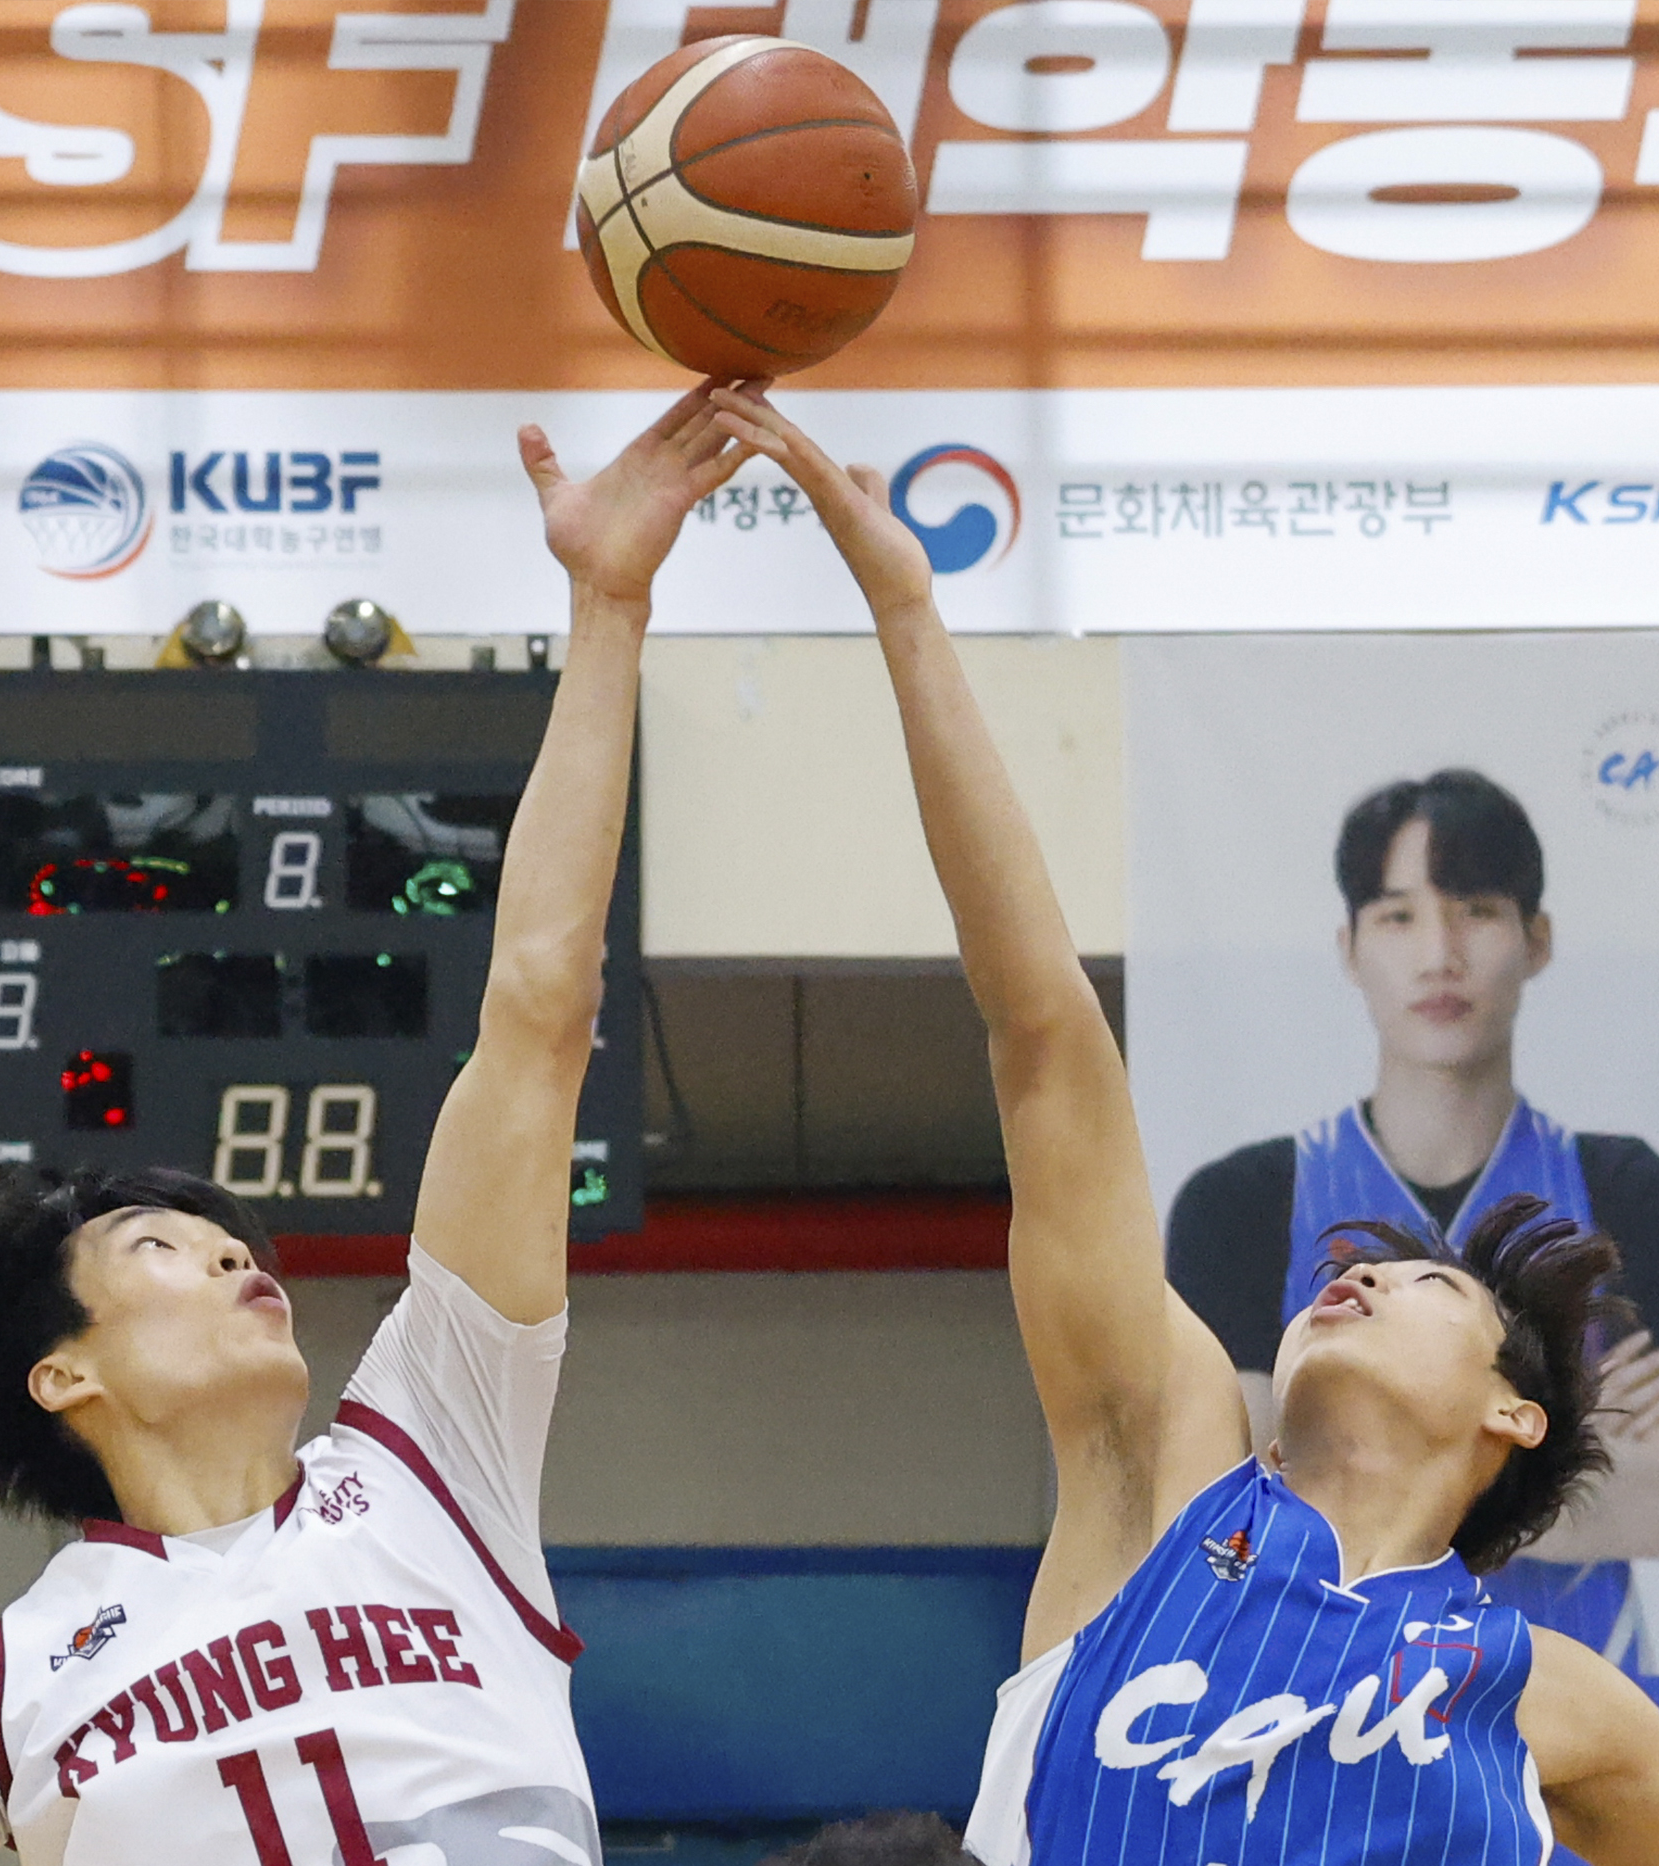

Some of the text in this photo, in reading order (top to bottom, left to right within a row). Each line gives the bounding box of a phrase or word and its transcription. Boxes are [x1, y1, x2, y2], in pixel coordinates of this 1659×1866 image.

[169, 451, 380, 514] KUBF
[697, 484, 822, 532] 정후
[1054, 478, 1454, 540] 문화체육관광부
[52, 1606, 483, 1798] KYUNG HEE
